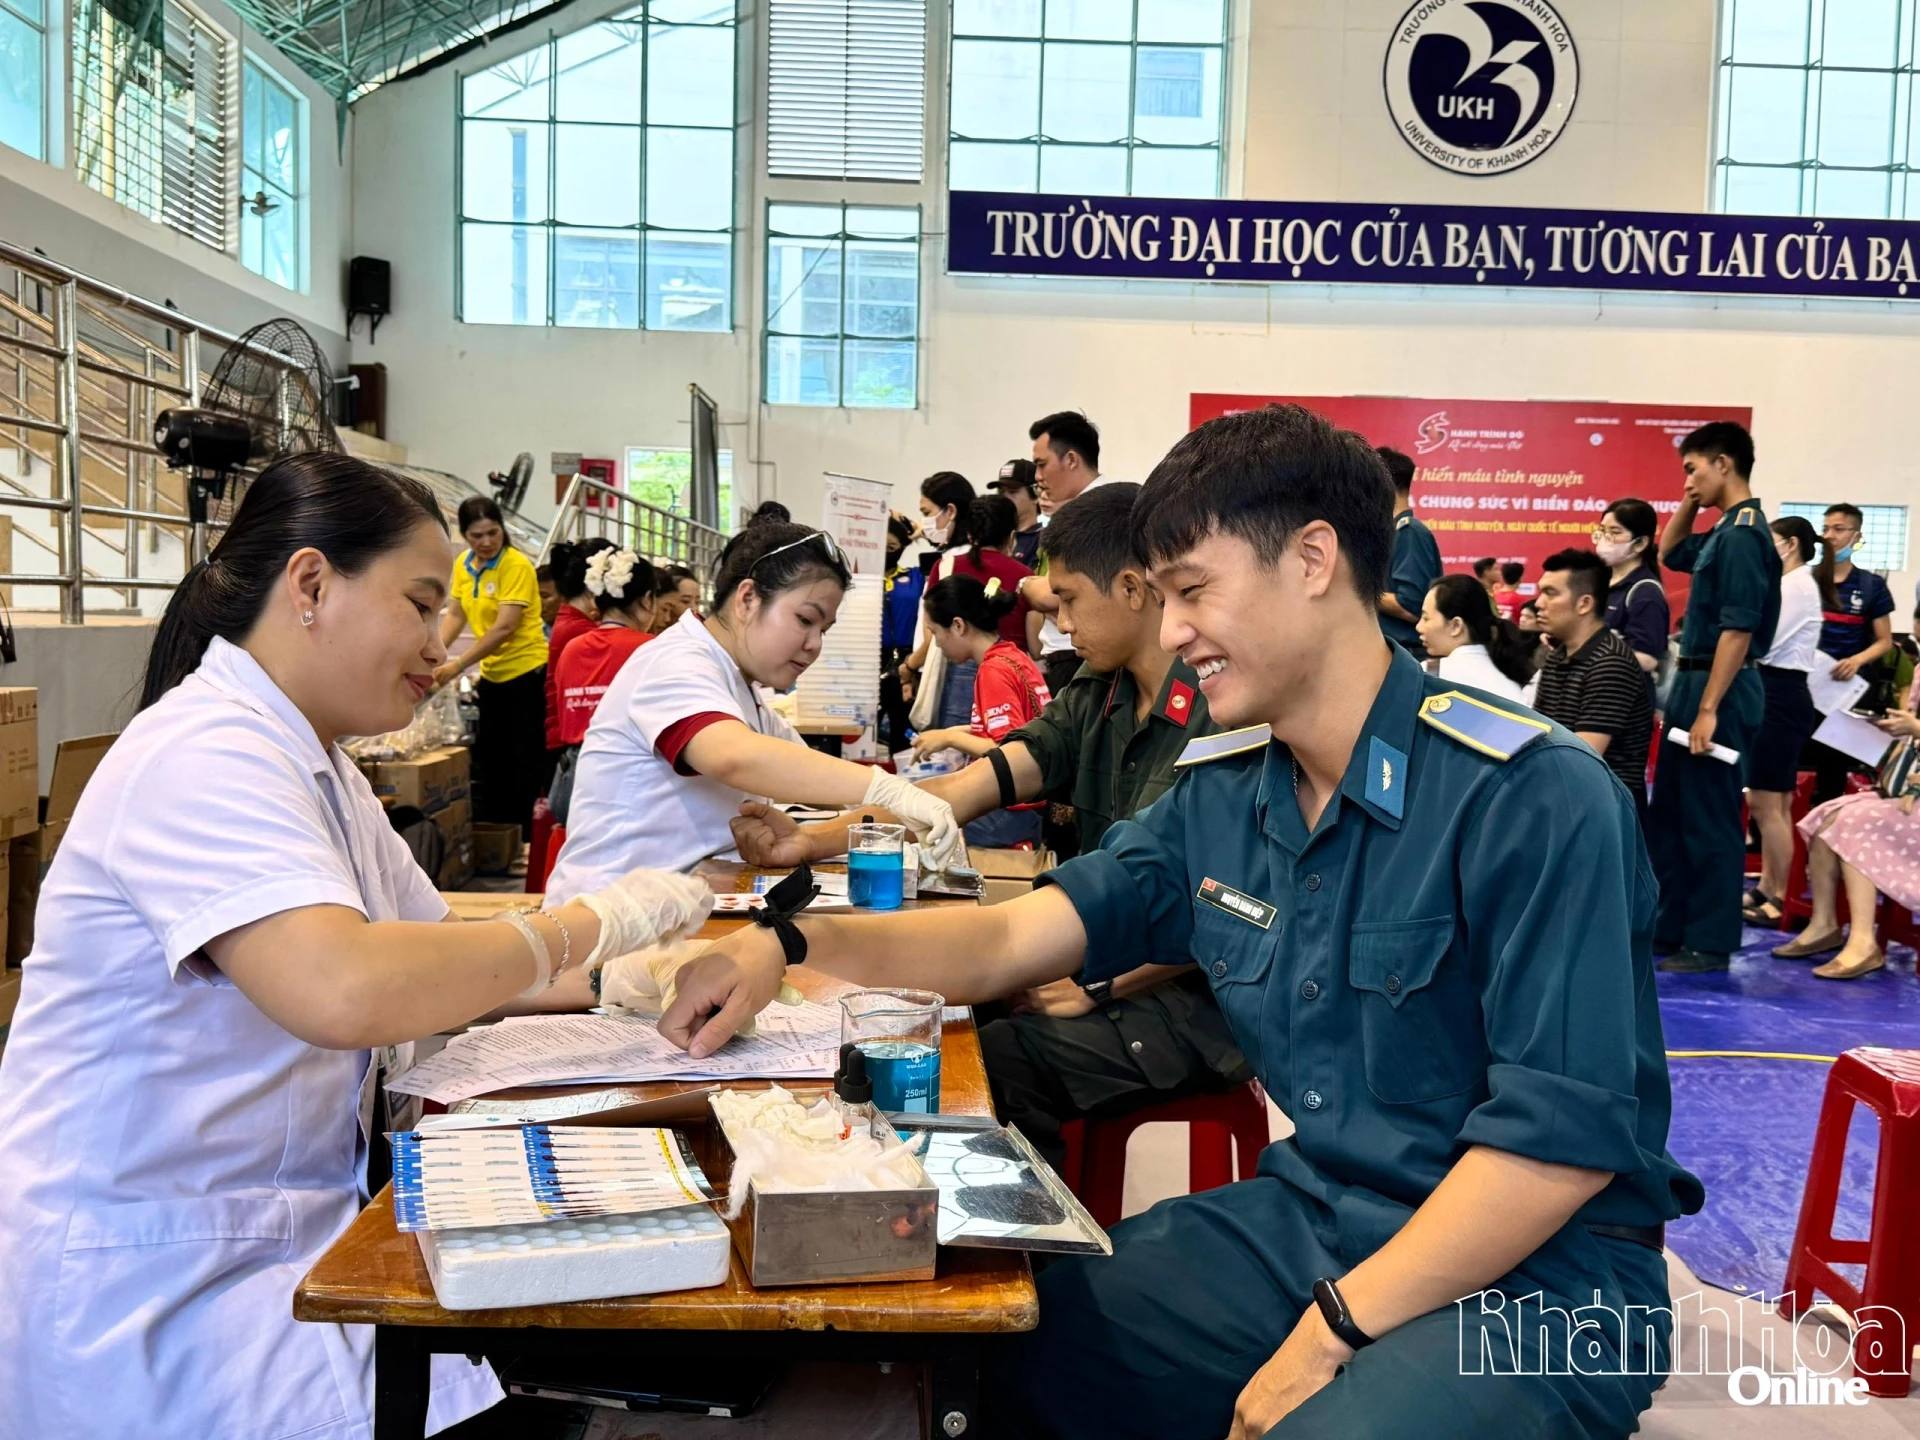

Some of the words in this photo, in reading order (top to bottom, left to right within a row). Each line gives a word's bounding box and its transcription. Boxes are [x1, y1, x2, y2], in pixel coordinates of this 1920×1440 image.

[1437, 95, 1495, 120] UKH
[1404, 120, 1466, 168] UNIVERSITY
[1467, 158, 1484, 169] OF
[1487, 147, 1529, 168] KHANH
[1529, 127, 1553, 151] HOA
[986, 200, 1163, 261] TRƯỜNG
[1169, 216, 1244, 277] ĐẠI
[1251, 218, 1342, 278] HỌC
[1351, 208, 1436, 267] CỦA
[1442, 223, 1536, 283] BẠN,
[1545, 219, 1690, 276] TƯƠNG
[1697, 231, 1768, 278] LAI
[1776, 220, 1858, 281] CỦA
[1865, 236, 1920, 295] BẠ
[1421, 466, 1454, 482] hiến
[1457, 468, 1491, 483] máu
[1495, 468, 1525, 483] tình
[1528, 471, 1584, 488] nguyện
[1418, 494, 1474, 509] CHUNG
[1477, 494, 1508, 510] SỨC
[1533, 493, 1569, 511] BIỂN
[904, 1087, 928, 1098] 250ml
